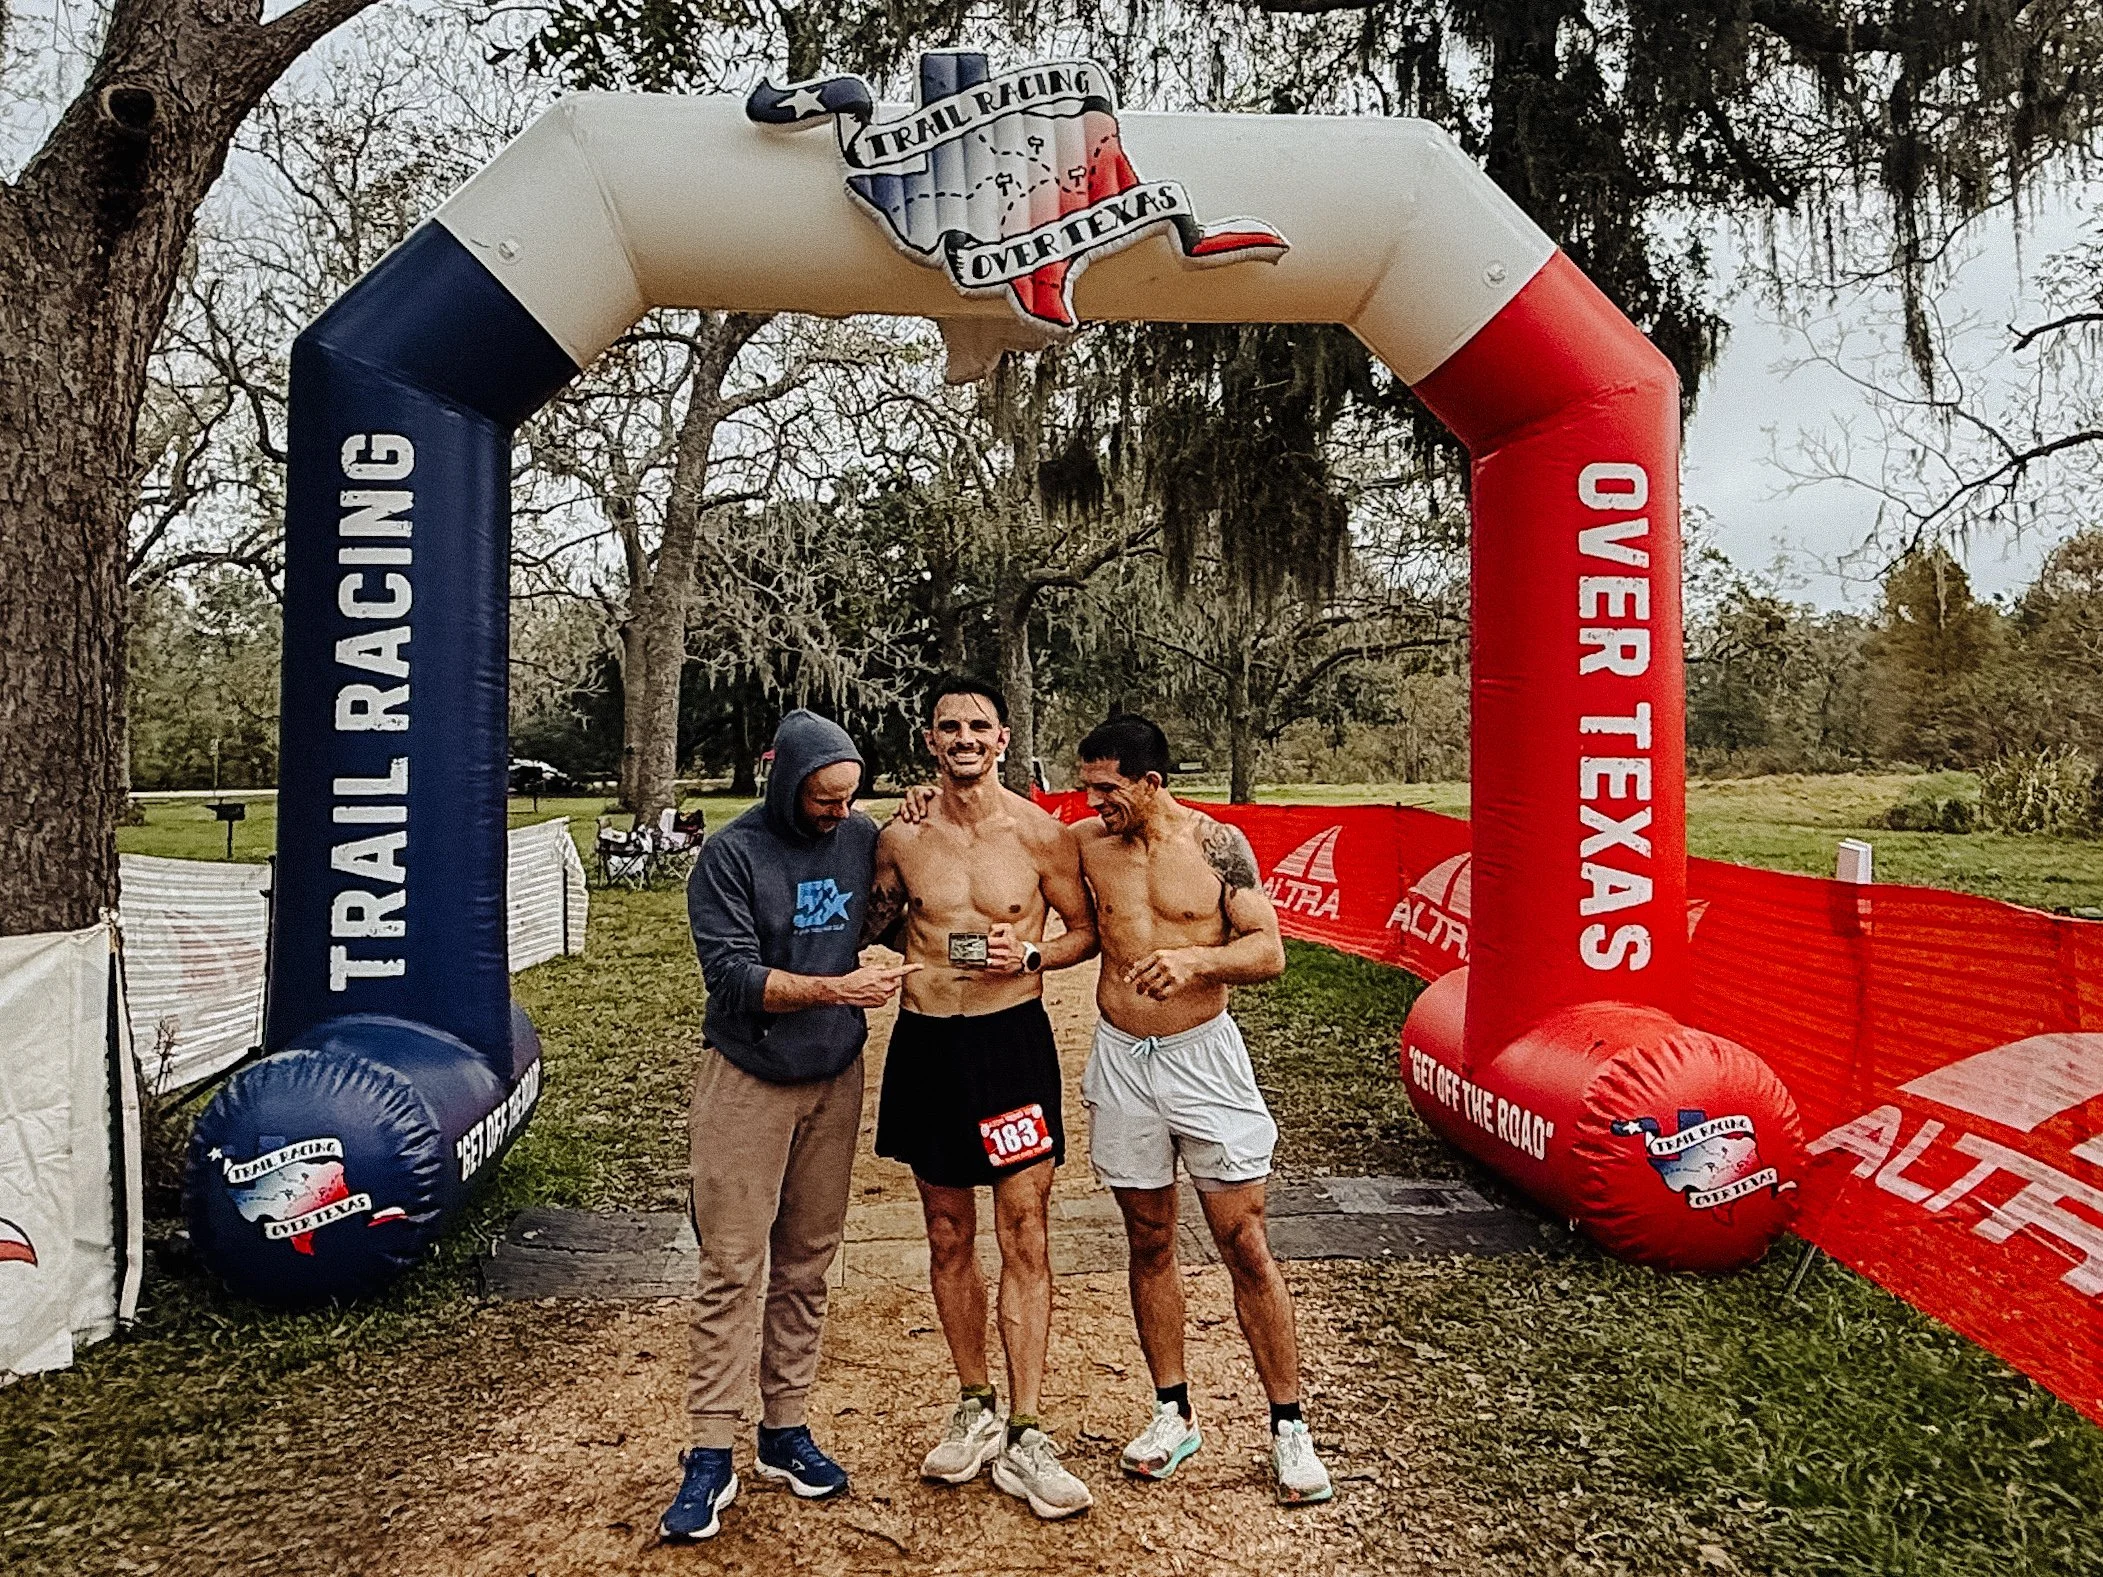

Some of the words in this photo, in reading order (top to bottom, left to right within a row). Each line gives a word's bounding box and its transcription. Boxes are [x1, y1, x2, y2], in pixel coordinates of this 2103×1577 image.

[865, 106, 973, 159] TRAIL
[972, 70, 1091, 116] RACING
[971, 235, 1059, 281] OVER
[1060, 184, 1178, 246] TEXAS
[335, 434, 414, 731] RACING
[1578, 462, 1650, 676] OVER
[1579, 702, 1653, 971] TEXAS
[330, 757, 408, 991] TRAIL
[1264, 876, 1340, 920] ALTRA
[1386, 896, 1470, 963] ALTR
[486, 1101, 508, 1159] OFF
[990, 1117, 1039, 1155] 183
[1409, 1045, 1437, 1096] "GET
[1436, 1065, 1460, 1112] OFF
[1462, 1079, 1494, 1134] THE
[1498, 1097, 1555, 1161] ROAD"
[232, 1161, 273, 1180] TRAIL
[279, 1141, 336, 1163] RACING
[1656, 1130, 1697, 1152] TRAIL
[272, 1220, 312, 1237] OVER
[314, 1196, 366, 1223] TEXAS
[1695, 1191, 1733, 1206] OVER
[1733, 1170, 1773, 1197] TEXAS
